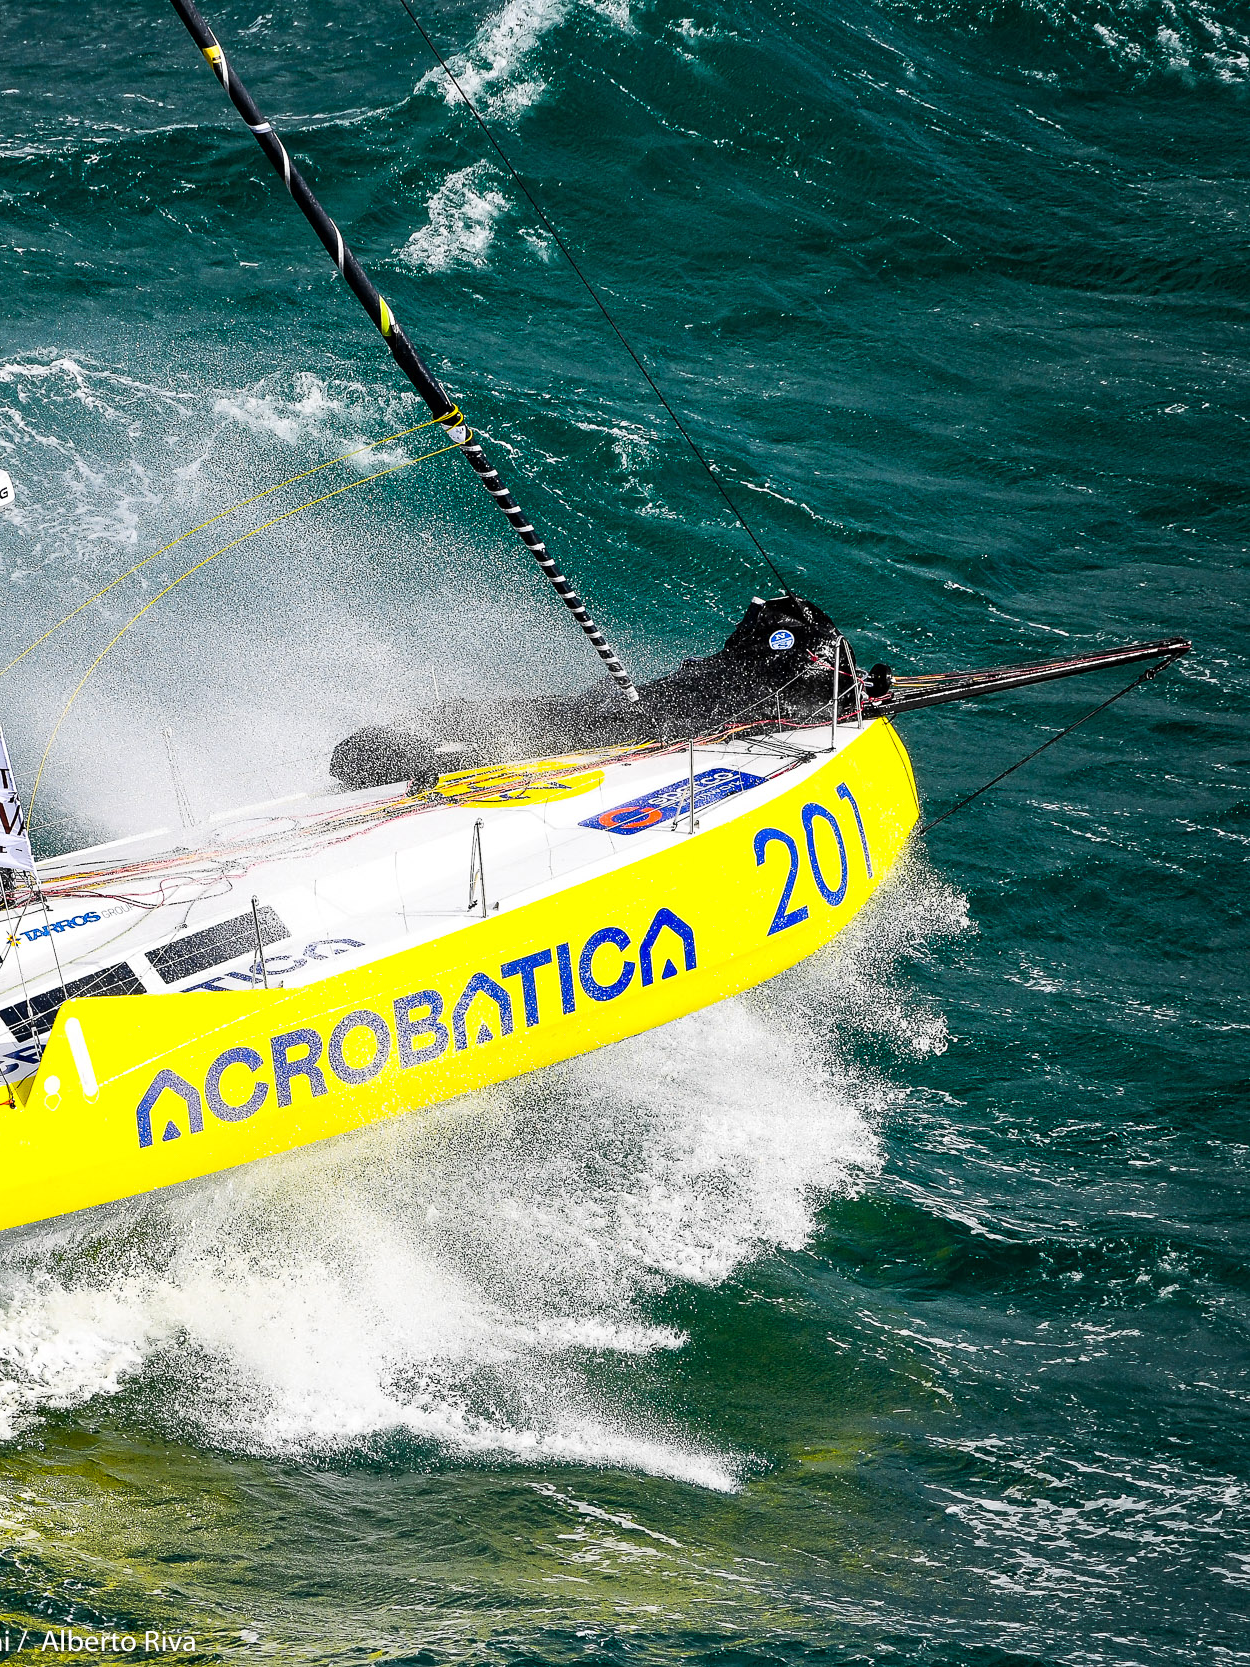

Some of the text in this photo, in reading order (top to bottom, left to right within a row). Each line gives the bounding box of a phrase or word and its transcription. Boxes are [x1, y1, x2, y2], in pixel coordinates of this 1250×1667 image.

[20, 911, 101, 942] TARROS
[753, 782, 873, 937] 201
[136, 907, 697, 1148] ACROBATICA
